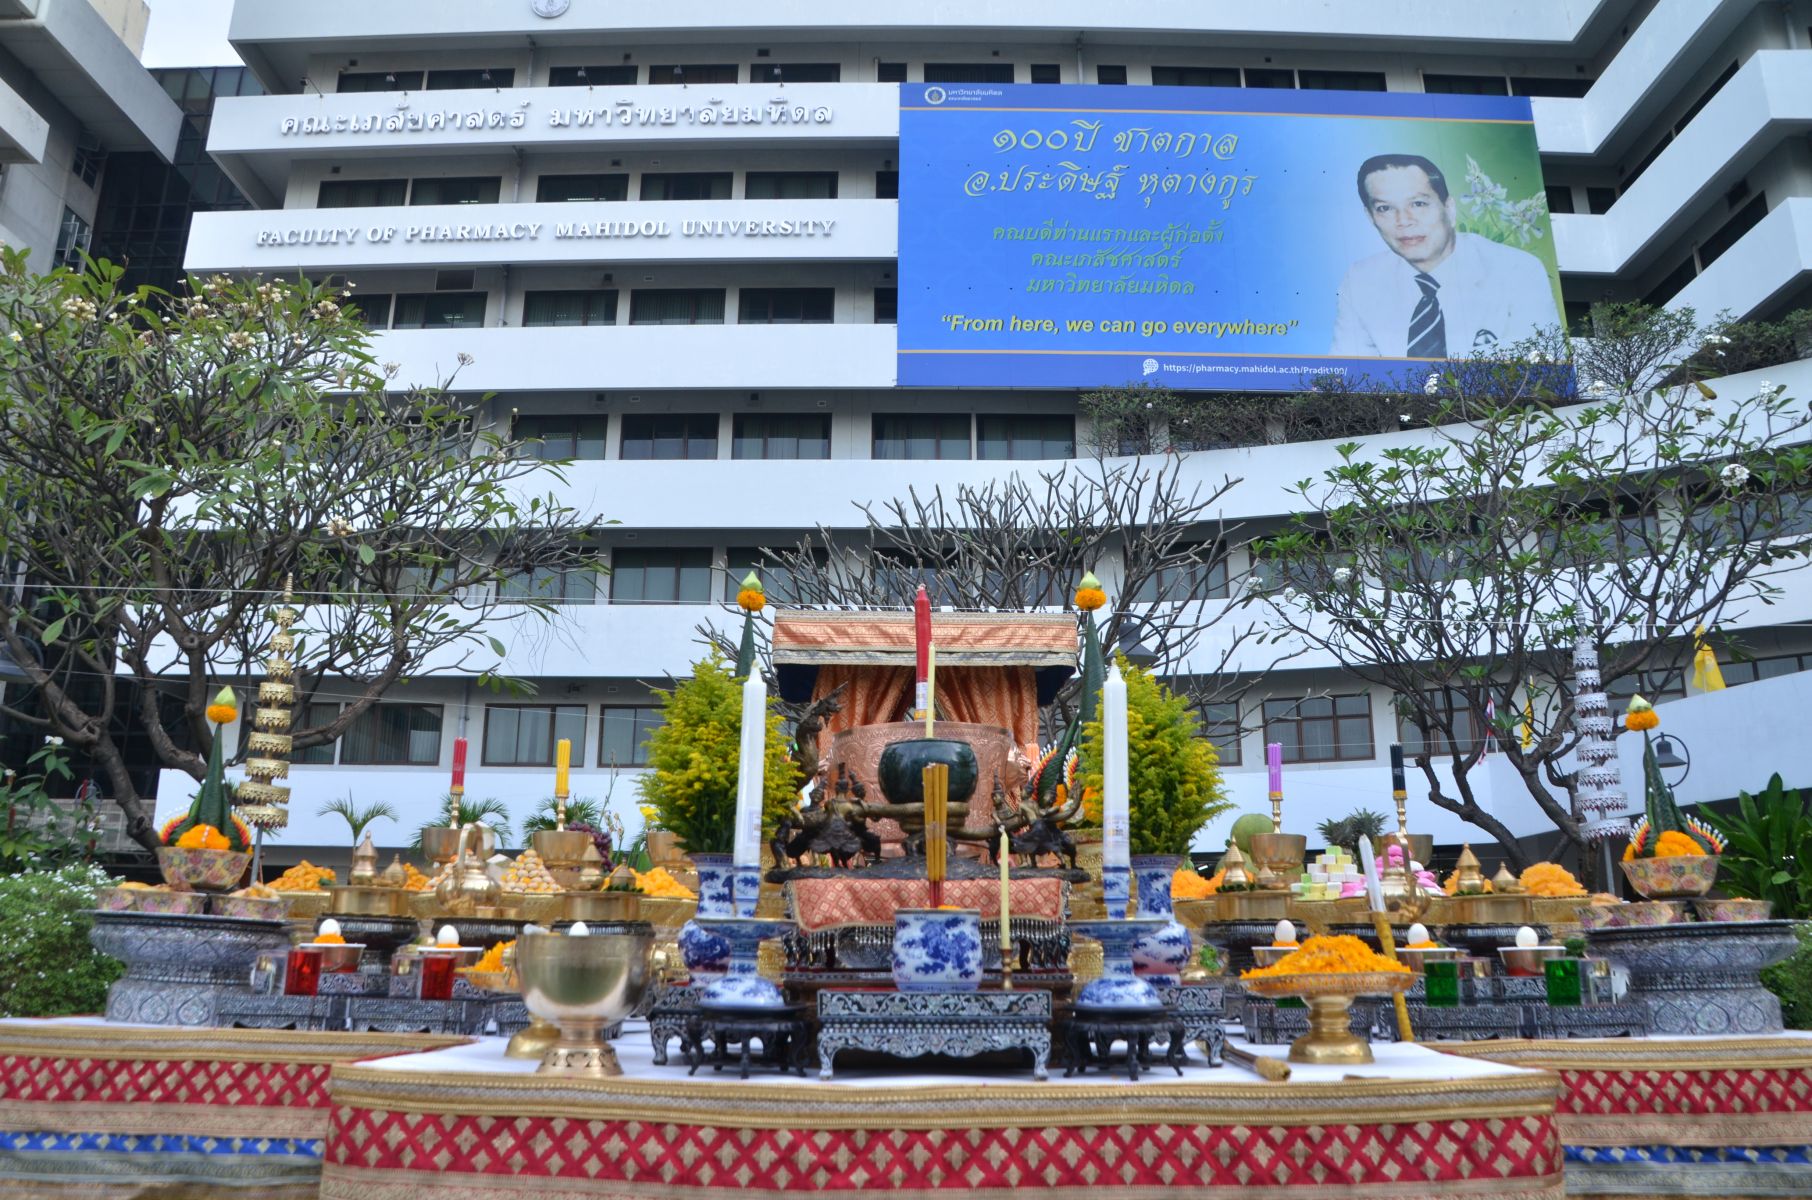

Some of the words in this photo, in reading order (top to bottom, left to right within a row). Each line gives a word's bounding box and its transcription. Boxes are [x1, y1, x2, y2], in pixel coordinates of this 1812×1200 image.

[549, 98, 834, 127] มหาวิทยาลัยมหิดล
[1113, 127, 1239, 160] ชาตกาล
[964, 160, 1129, 200] อ.ประดิษฐ์
[1138, 171, 1258, 210] หุตางกูร
[256, 227, 360, 247] FACULTY
[366, 224, 398, 242] OF
[404, 223, 542, 242] PHARMACY
[554, 220, 672, 239] MAHIDOL
[681, 219, 837, 237] UNIVERSITY
[992, 218, 1224, 249] คณบดีท่านแรกและผู้ก่อตั้ง
[1031, 246, 1188, 268] คณะเภสัชศาสตร์
[1026, 271, 1195, 294] มหาวิทยาลัยมหิดล
[1009, 316, 1060, 334] here,
[1066, 320, 1094, 332] we
[1100, 321, 1137, 333] can
[1142, 322, 1168, 337] go
[1163, 364, 1348, 376] https://pharmacy.mahidol.ac.th/Pradit100/
